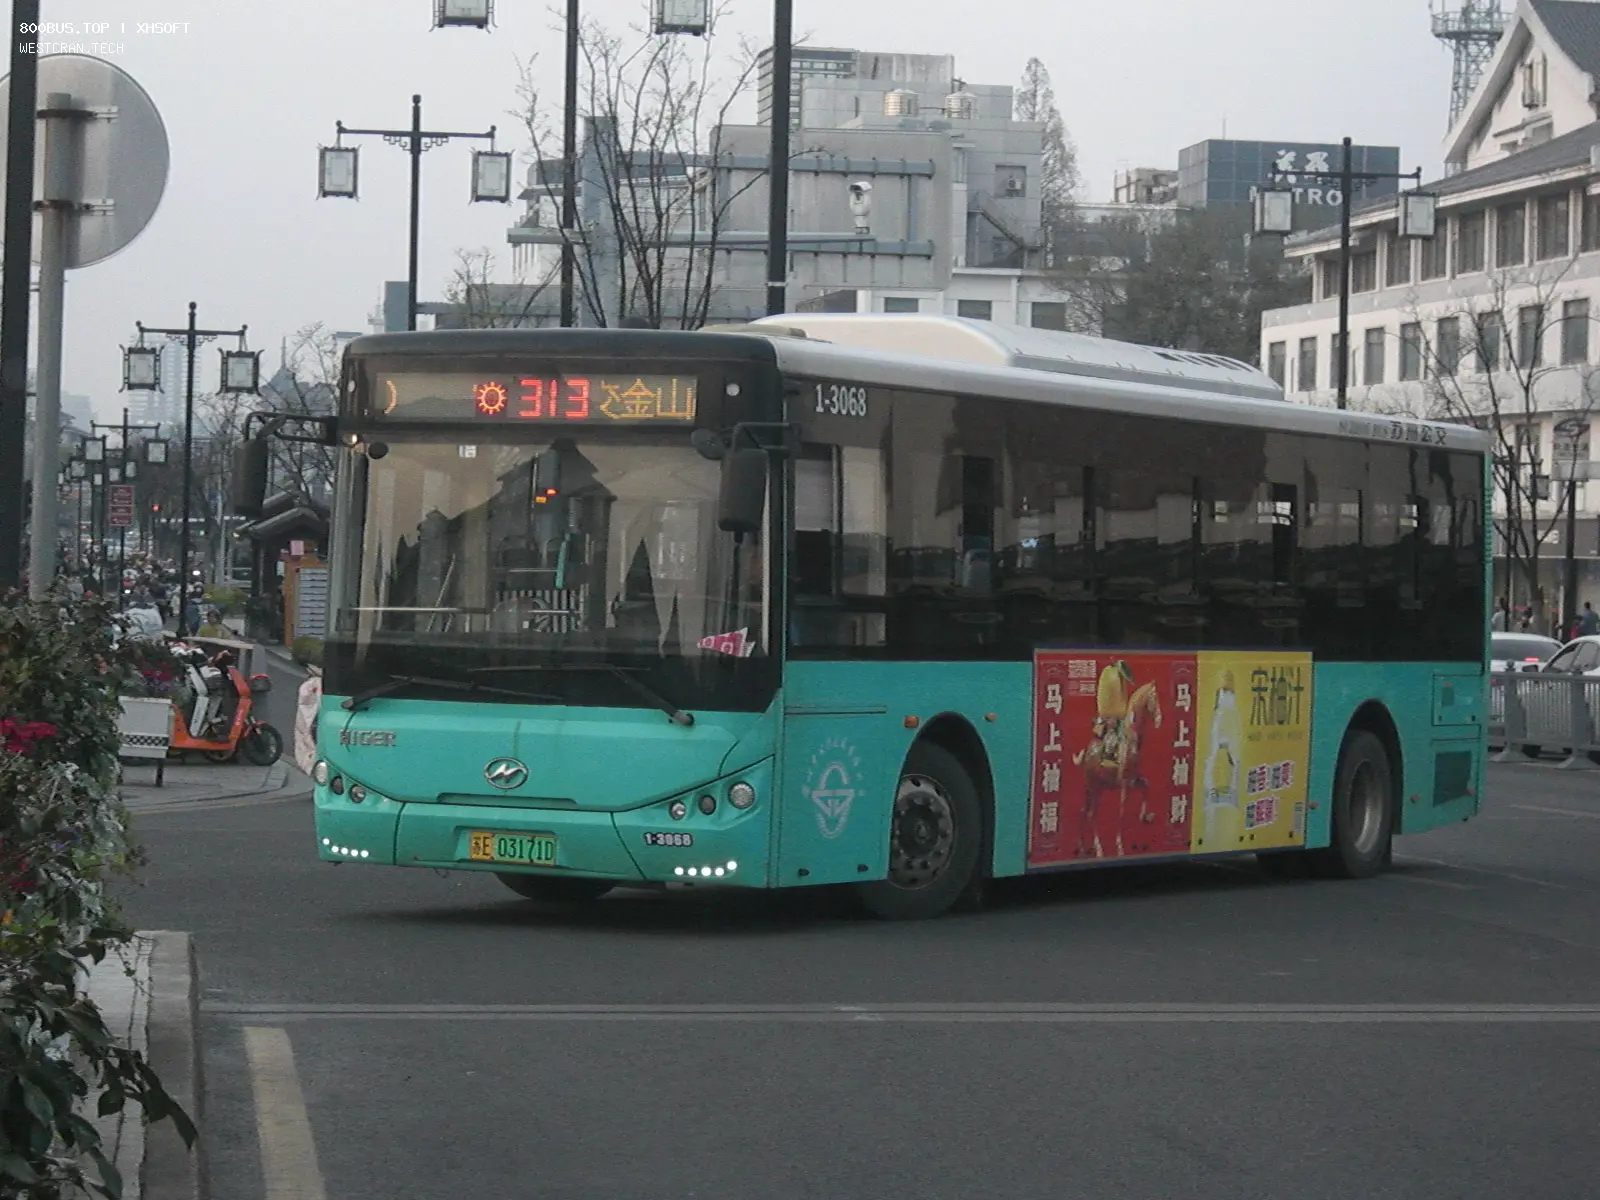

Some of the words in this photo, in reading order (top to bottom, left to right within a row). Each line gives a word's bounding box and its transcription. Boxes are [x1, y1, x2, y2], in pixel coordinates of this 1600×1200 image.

[519, 379, 590, 418] 313
[816, 383, 866, 416] 1-3068
[644, 832, 692, 846] 1-3068
